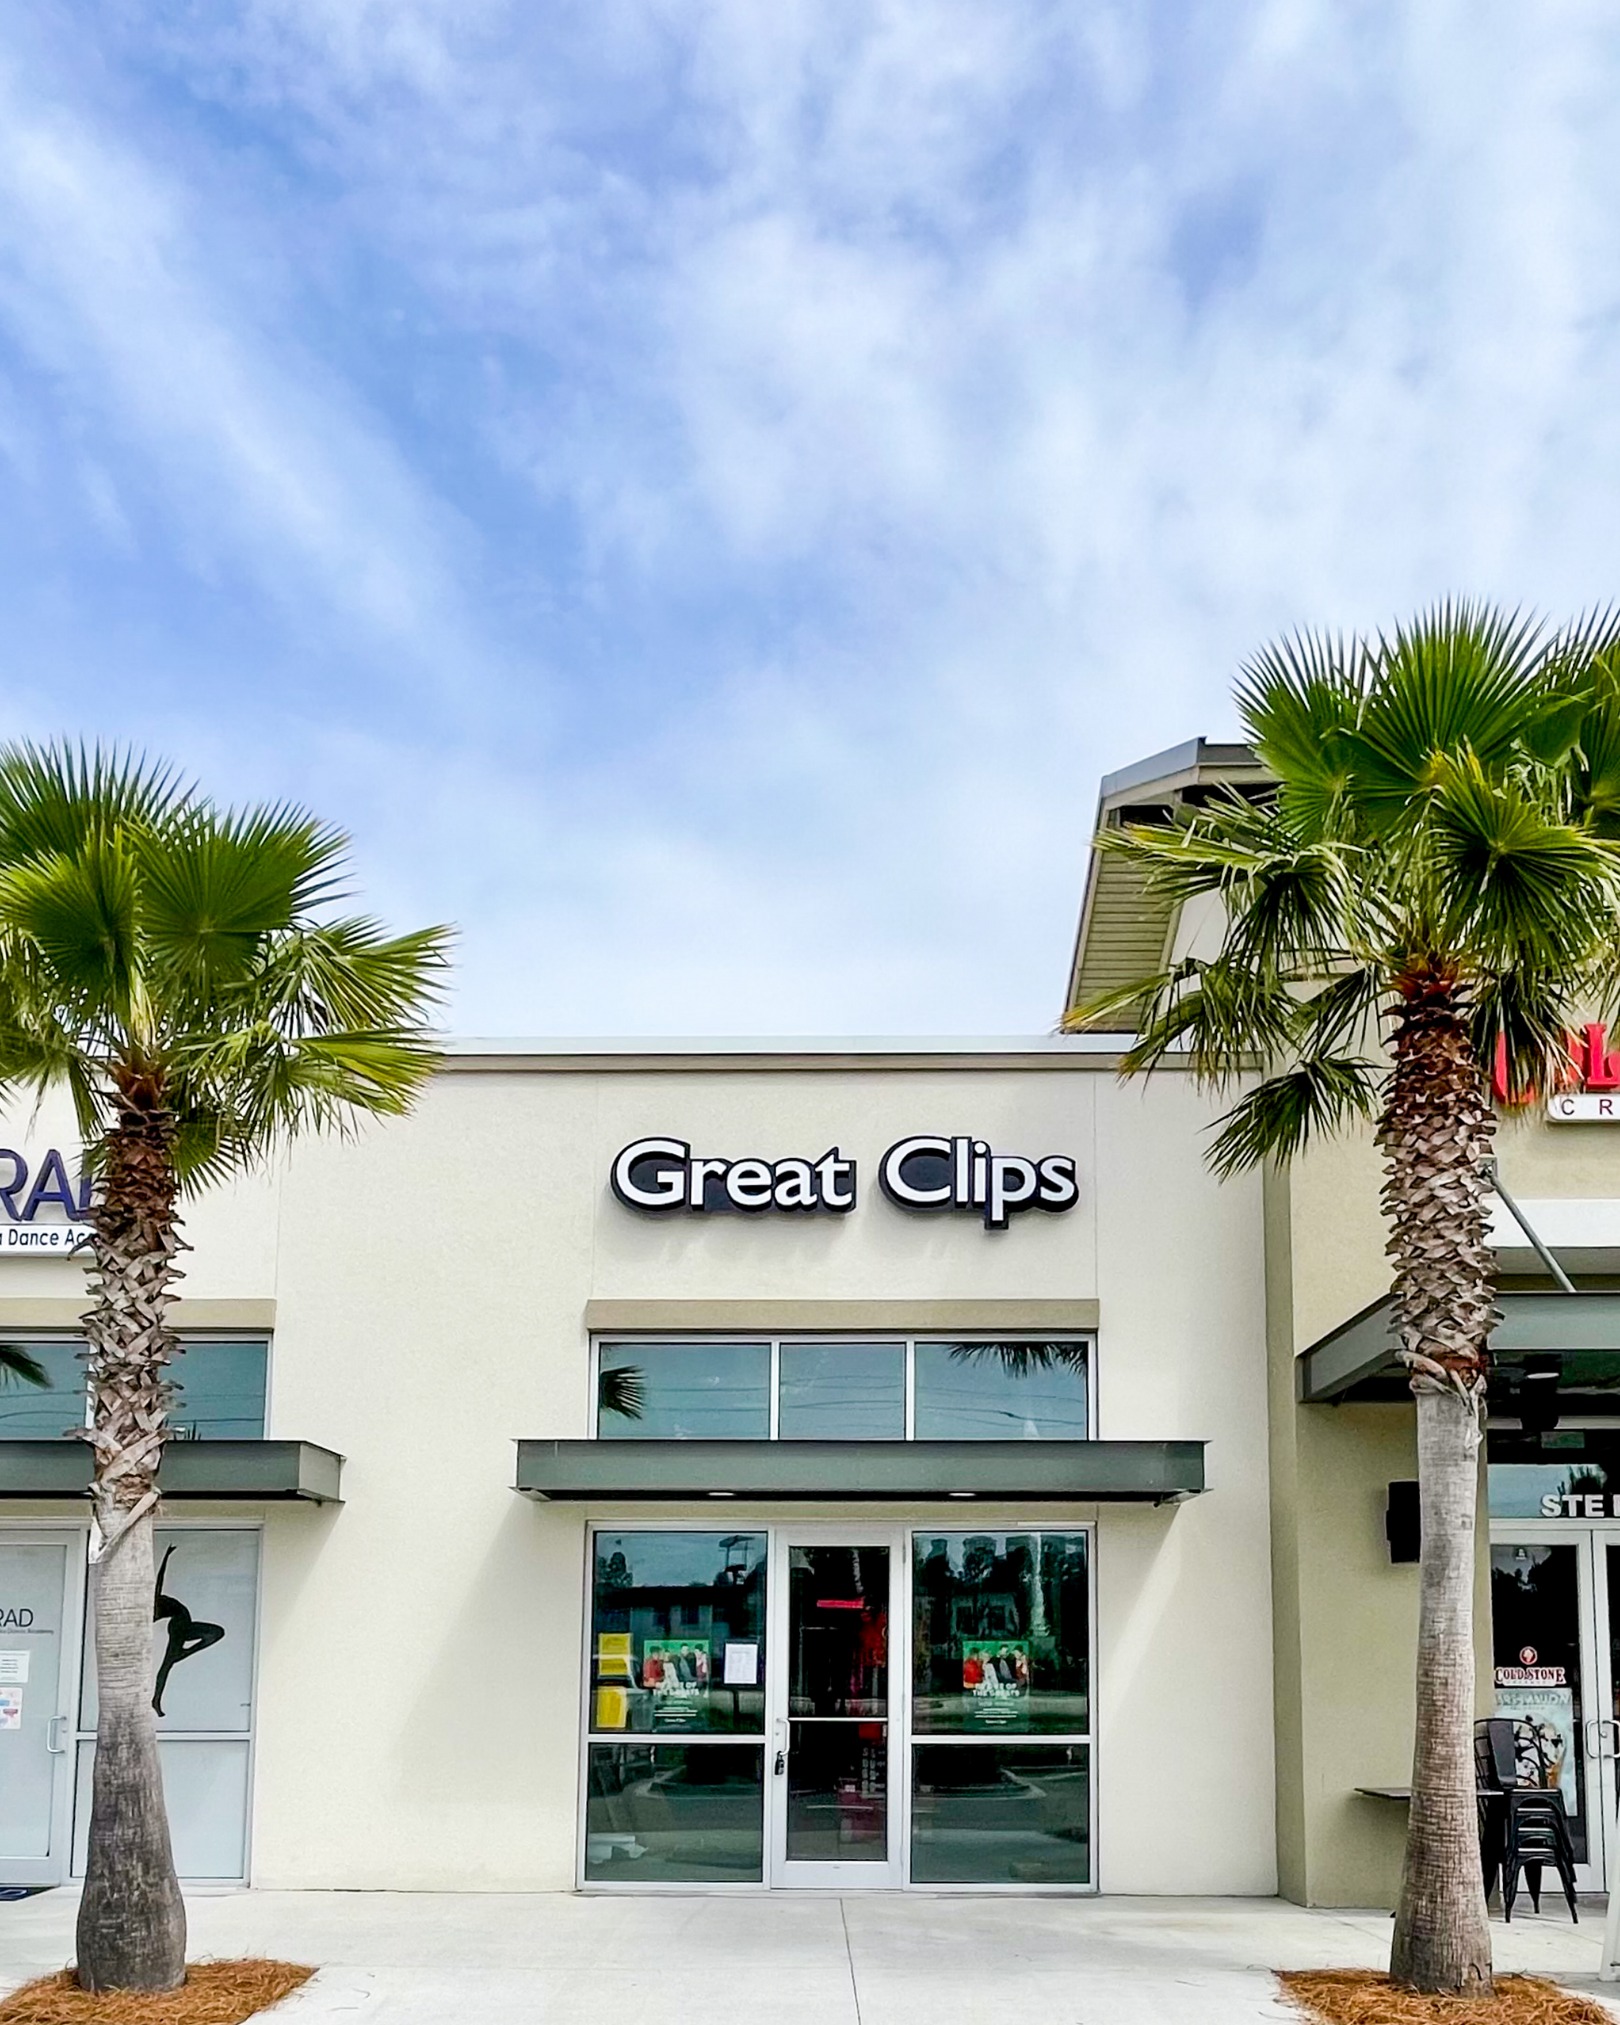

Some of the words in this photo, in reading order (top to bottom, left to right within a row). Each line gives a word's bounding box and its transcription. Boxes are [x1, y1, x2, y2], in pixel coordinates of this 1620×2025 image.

[613, 1138, 855, 1210] Great
[882, 1136, 1077, 1225] Clips
[9, 1228, 59, 1246] Dance
[1541, 1494, 1605, 1517] STE
[1526, 1668, 1564, 1682] STONE
